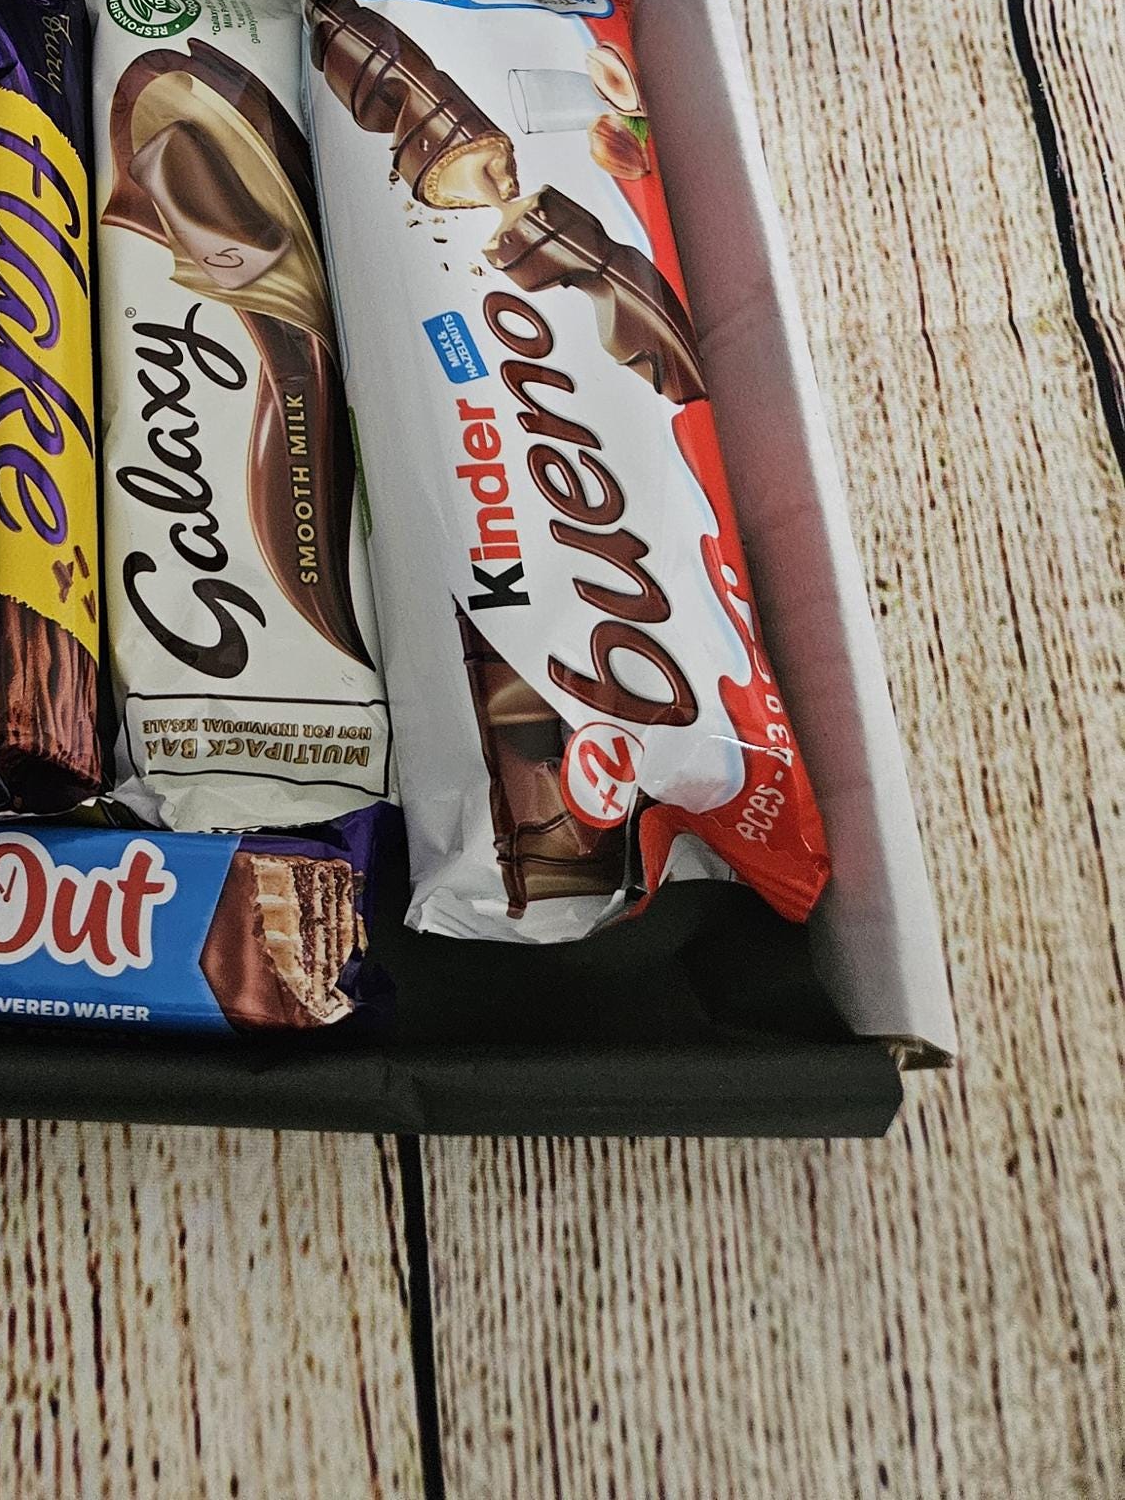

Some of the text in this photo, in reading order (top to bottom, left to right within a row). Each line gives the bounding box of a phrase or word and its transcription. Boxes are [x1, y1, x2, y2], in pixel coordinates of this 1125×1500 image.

[439, 339, 462, 368] MILK
[442, 314, 480, 379] HAZELNUTS
[115, 302, 267, 680] Galaxy
[286, 393, 319, 585] SMOOTH MILK
[142, 717, 372, 740] NOT FOR INDIVIDUAL RESALE
[208, 735, 370, 767] MULTIPACK
[72, 1001, 151, 1023] WAFER
